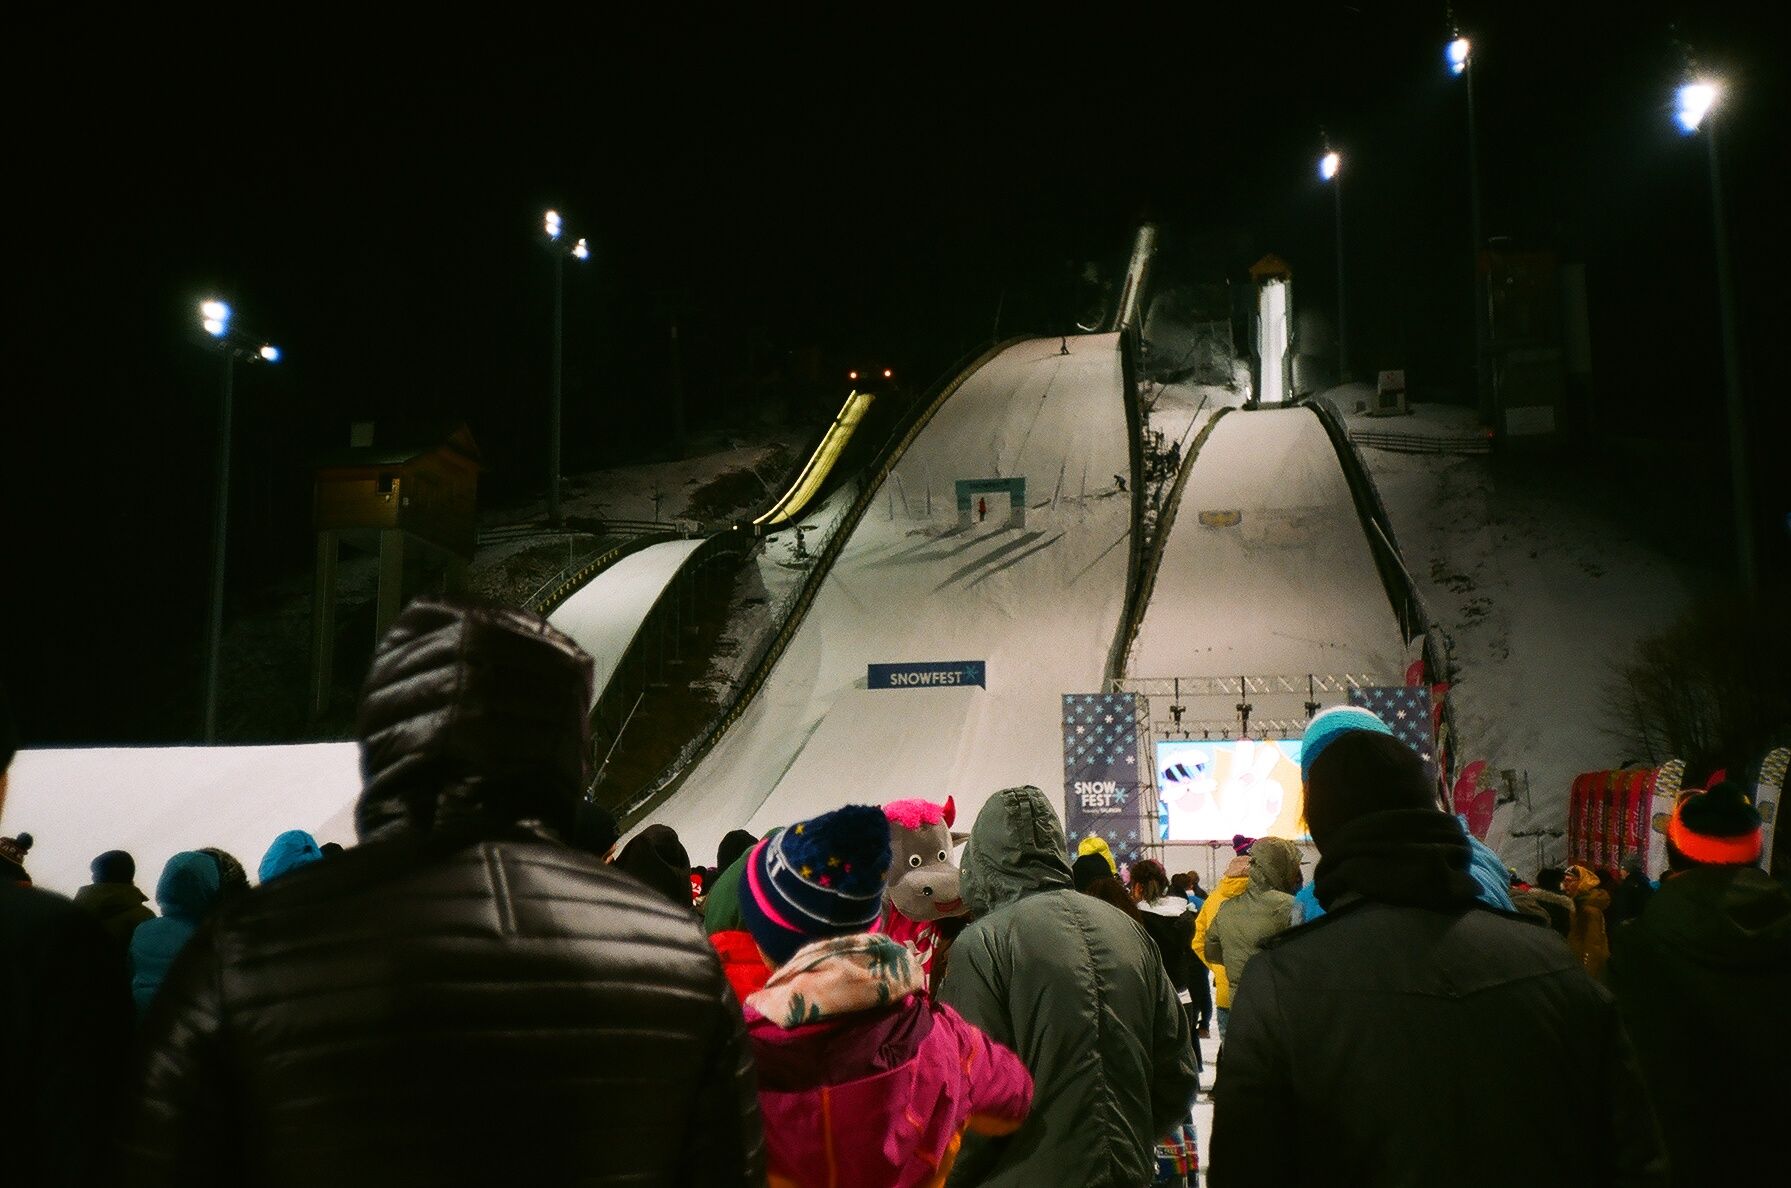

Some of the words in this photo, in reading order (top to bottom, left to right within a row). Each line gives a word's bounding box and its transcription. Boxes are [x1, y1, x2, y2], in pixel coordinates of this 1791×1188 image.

[890, 671, 962, 685] SNOWFEST
[1074, 781, 1116, 794] SNOW
[1082, 794, 1112, 807] FEST
